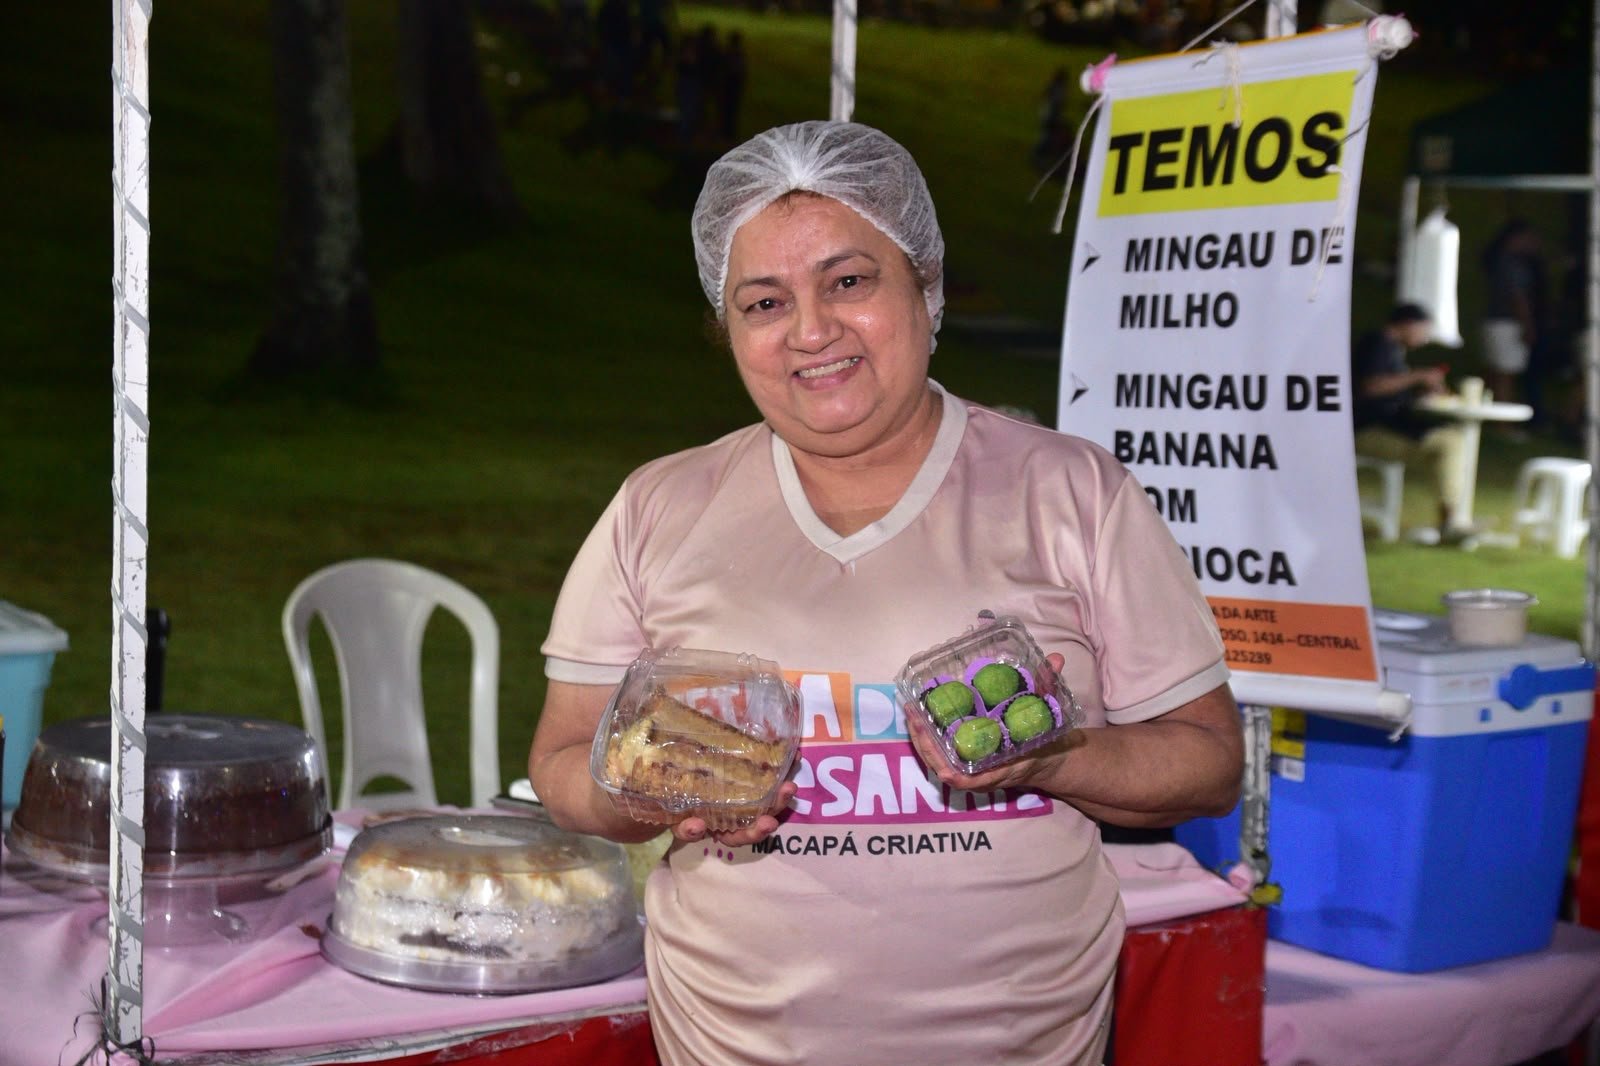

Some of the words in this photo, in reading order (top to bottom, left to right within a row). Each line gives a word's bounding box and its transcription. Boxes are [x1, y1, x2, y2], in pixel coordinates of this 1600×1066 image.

[1109, 112, 1345, 196] TEMOS
[1125, 230, 1275, 272] MINGAU
[1290, 227, 1345, 266] DE
[1120, 291, 1239, 329] MILHO
[1115, 373, 1268, 411] MINGAU
[1286, 375, 1341, 412] DE
[1114, 430, 1278, 470] BANANA
[1181, 546, 1297, 586] IOCA
[1221, 606, 1242, 619] DA
[1244, 608, 1277, 623] ARTE
[752, 832, 858, 857] MACAPÁ
[867, 830, 992, 855] CRIATIVA
